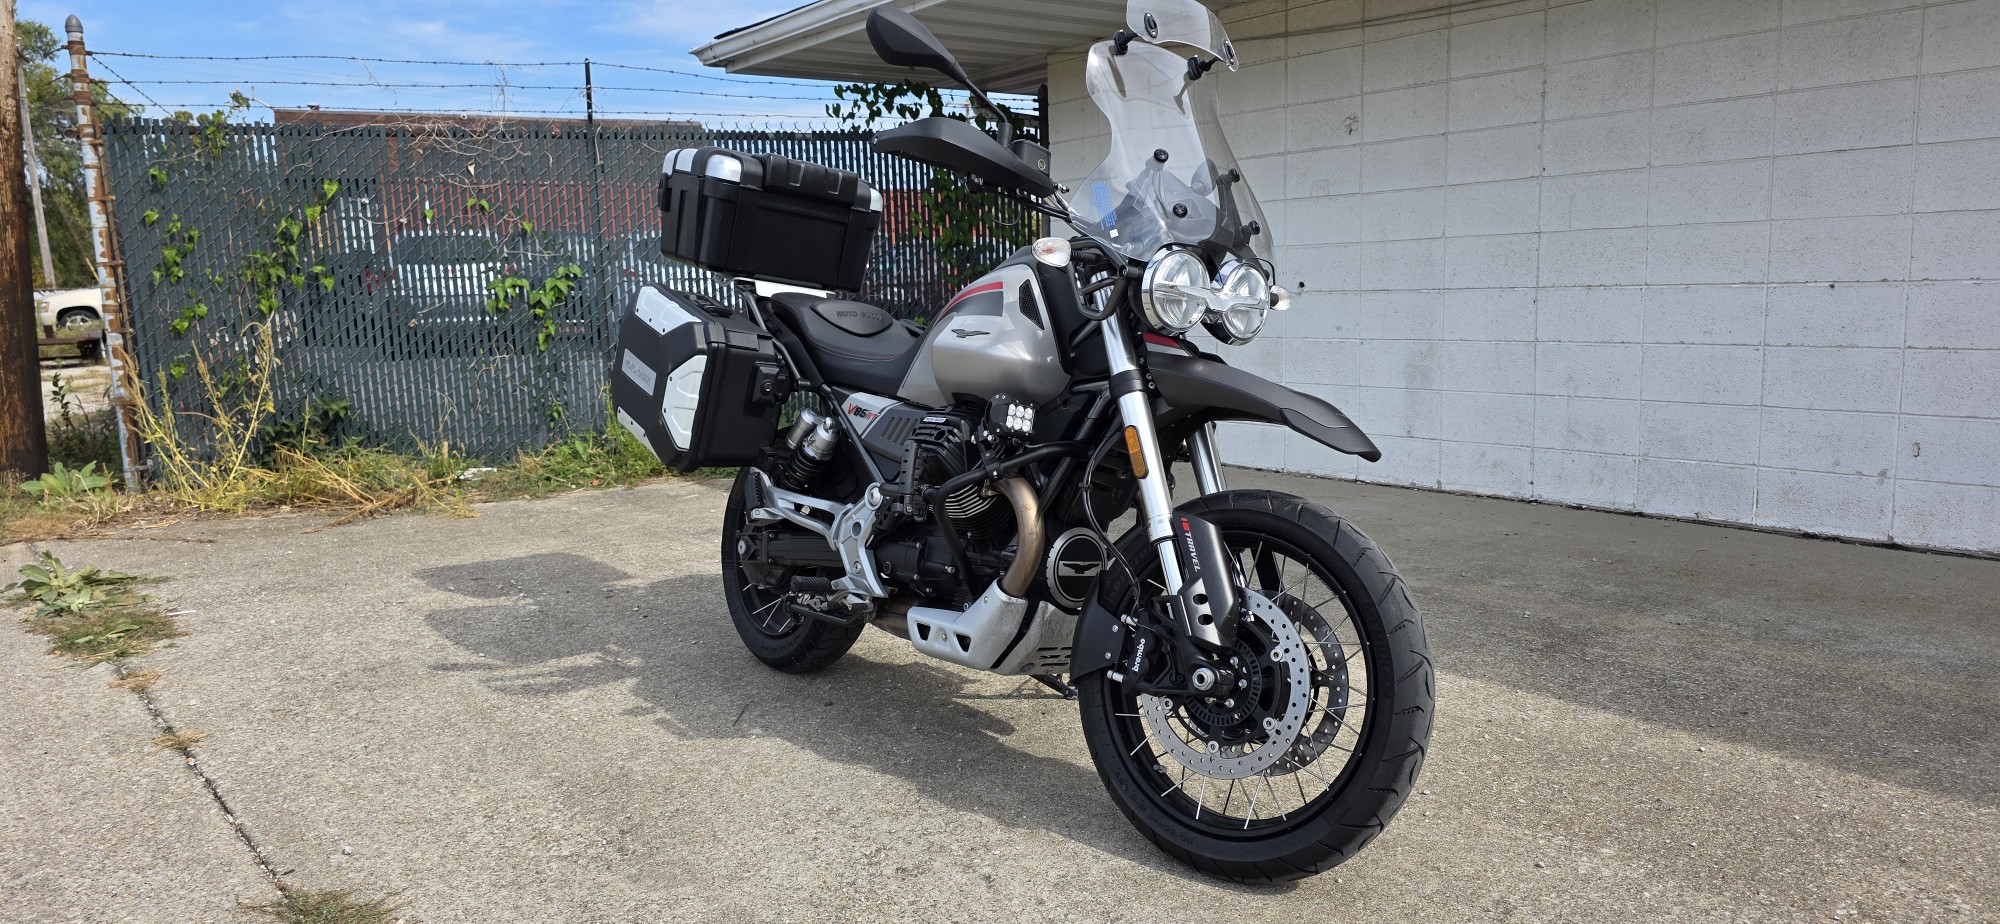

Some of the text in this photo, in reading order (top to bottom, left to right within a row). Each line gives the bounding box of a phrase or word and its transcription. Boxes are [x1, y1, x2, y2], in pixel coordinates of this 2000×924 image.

[836, 310, 858, 318] MOTO
[1185, 531, 1201, 573] TRAVEL
[1131, 638, 1146, 672] brembo
